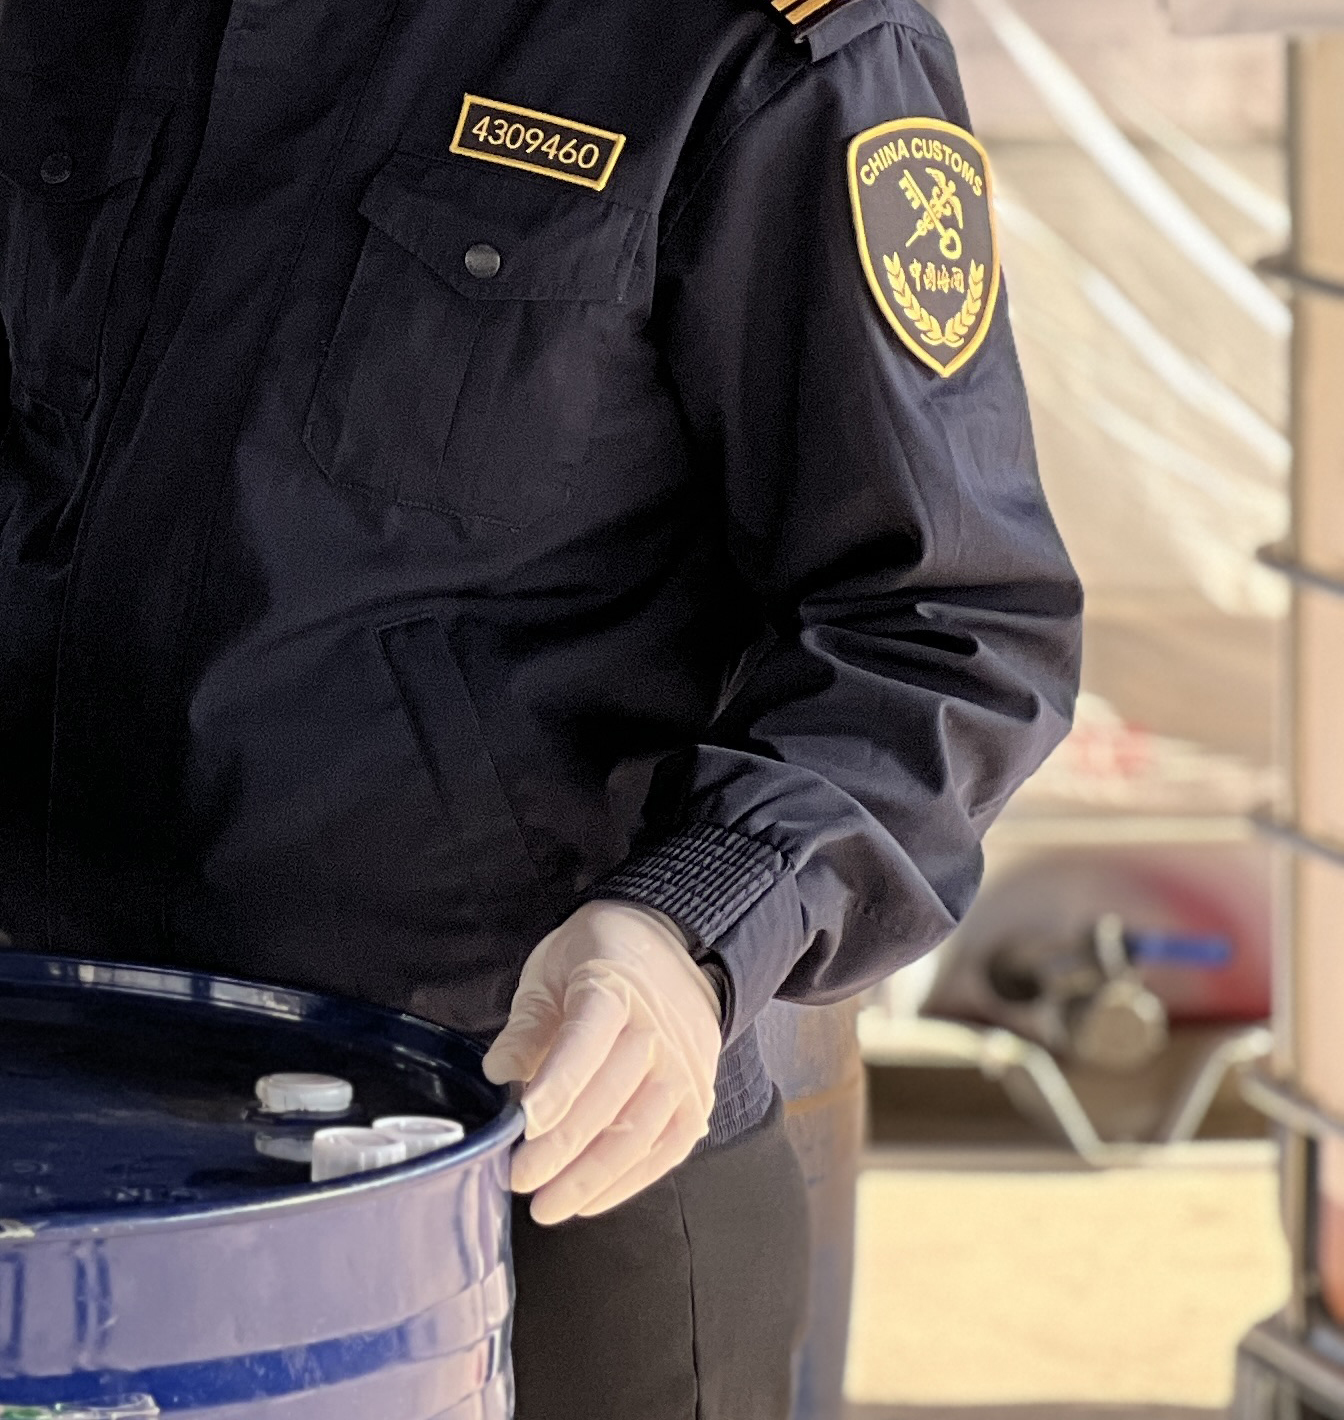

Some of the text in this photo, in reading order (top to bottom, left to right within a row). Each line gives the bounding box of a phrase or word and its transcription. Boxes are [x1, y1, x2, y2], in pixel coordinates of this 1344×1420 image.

[471, 115, 600, 169] 4309460
[859, 137, 984, 197] CHINA CUSTOMS
